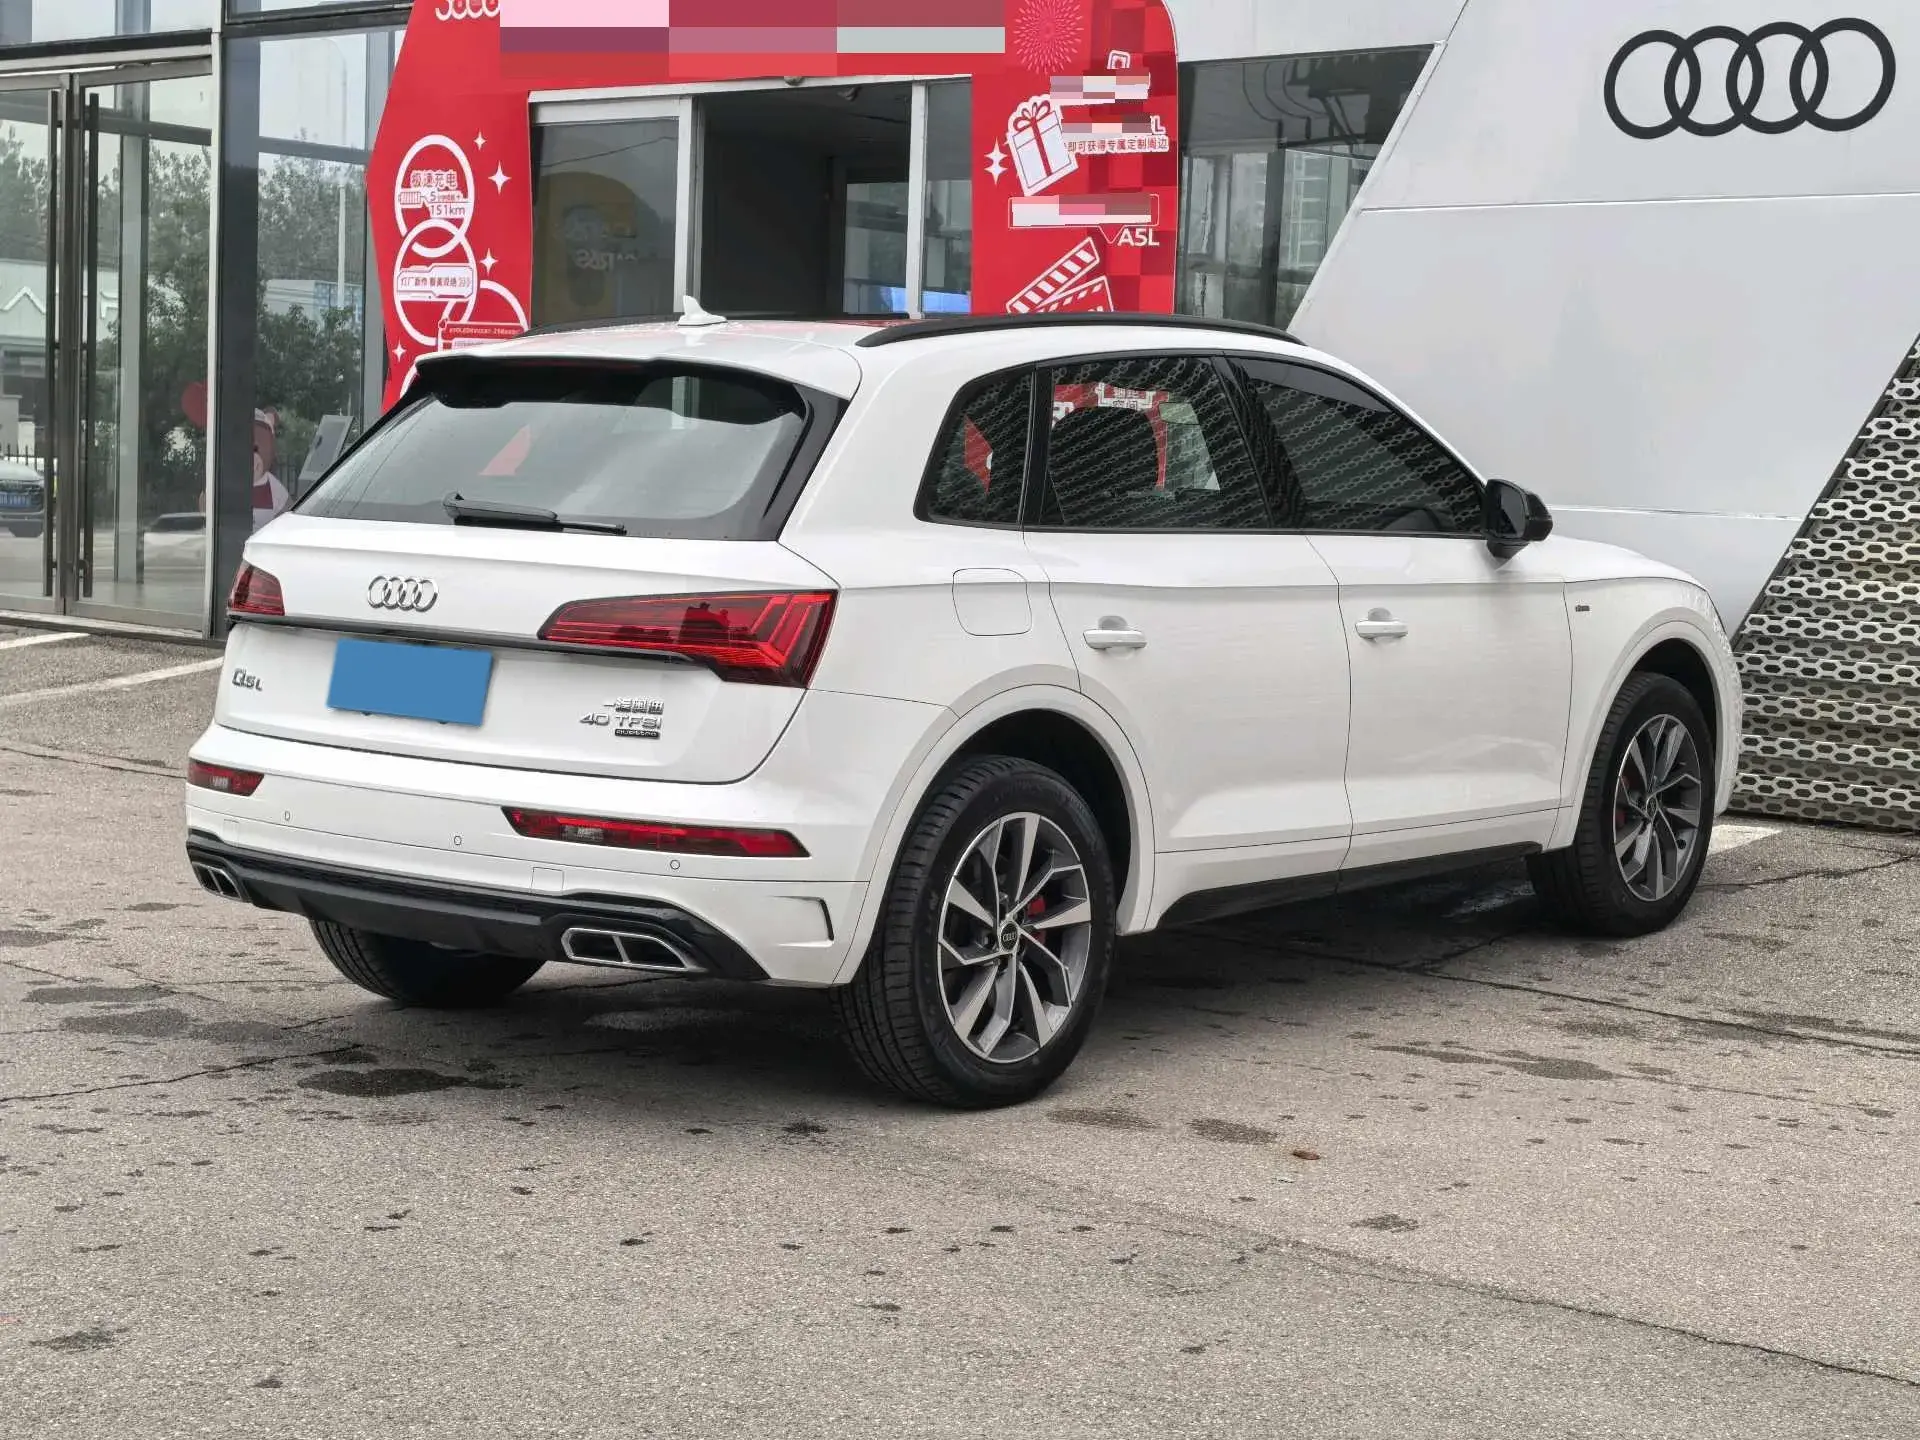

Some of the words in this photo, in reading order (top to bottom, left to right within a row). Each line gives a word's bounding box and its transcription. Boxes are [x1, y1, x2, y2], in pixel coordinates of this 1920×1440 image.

[1065, 136, 1168, 152] 即可获得专属定制周边
[412, 172, 457, 188] 极速充电
[431, 204, 466, 216] 151km
[1117, 227, 1160, 247] A5L
[232, 668, 263, 692] Q5L
[579, 713, 610, 726] 40
[615, 715, 662, 730] TFSI
